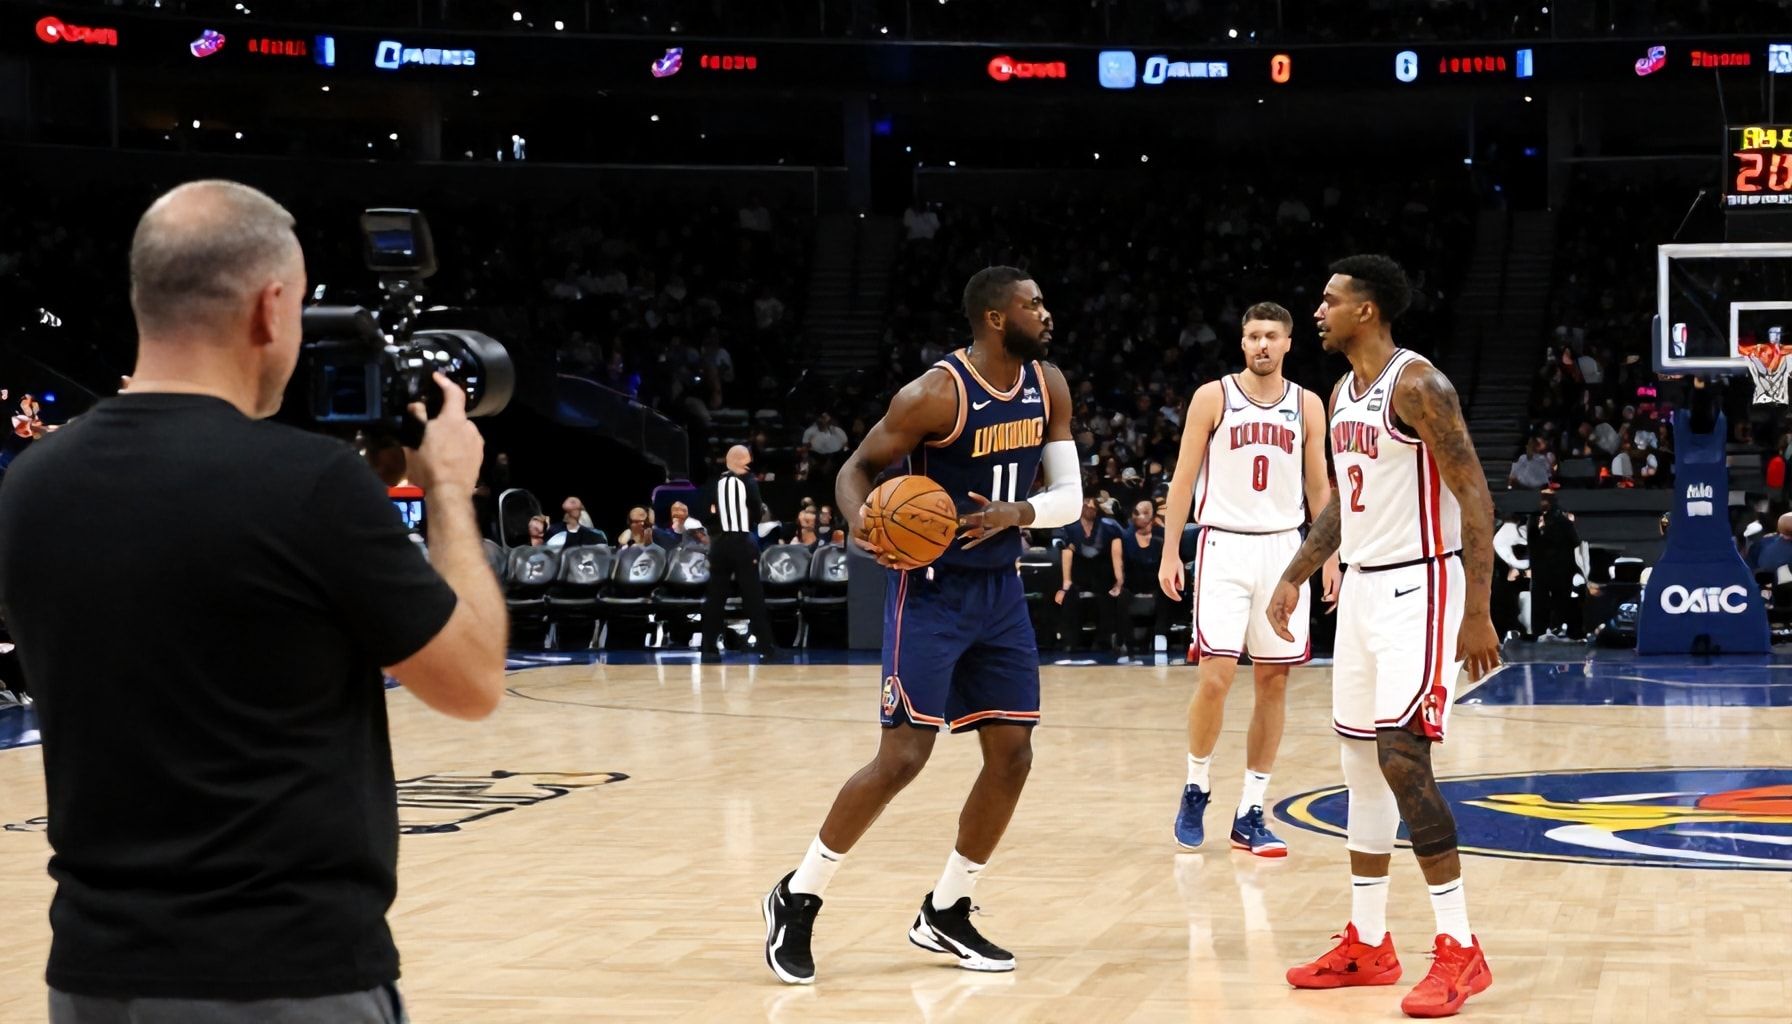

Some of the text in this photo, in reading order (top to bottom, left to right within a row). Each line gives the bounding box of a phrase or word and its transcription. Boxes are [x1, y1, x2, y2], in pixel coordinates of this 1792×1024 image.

[991, 462, 1018, 502] 11
[1252, 455, 1269, 492] 0
[1347, 464, 1366, 512] 2
